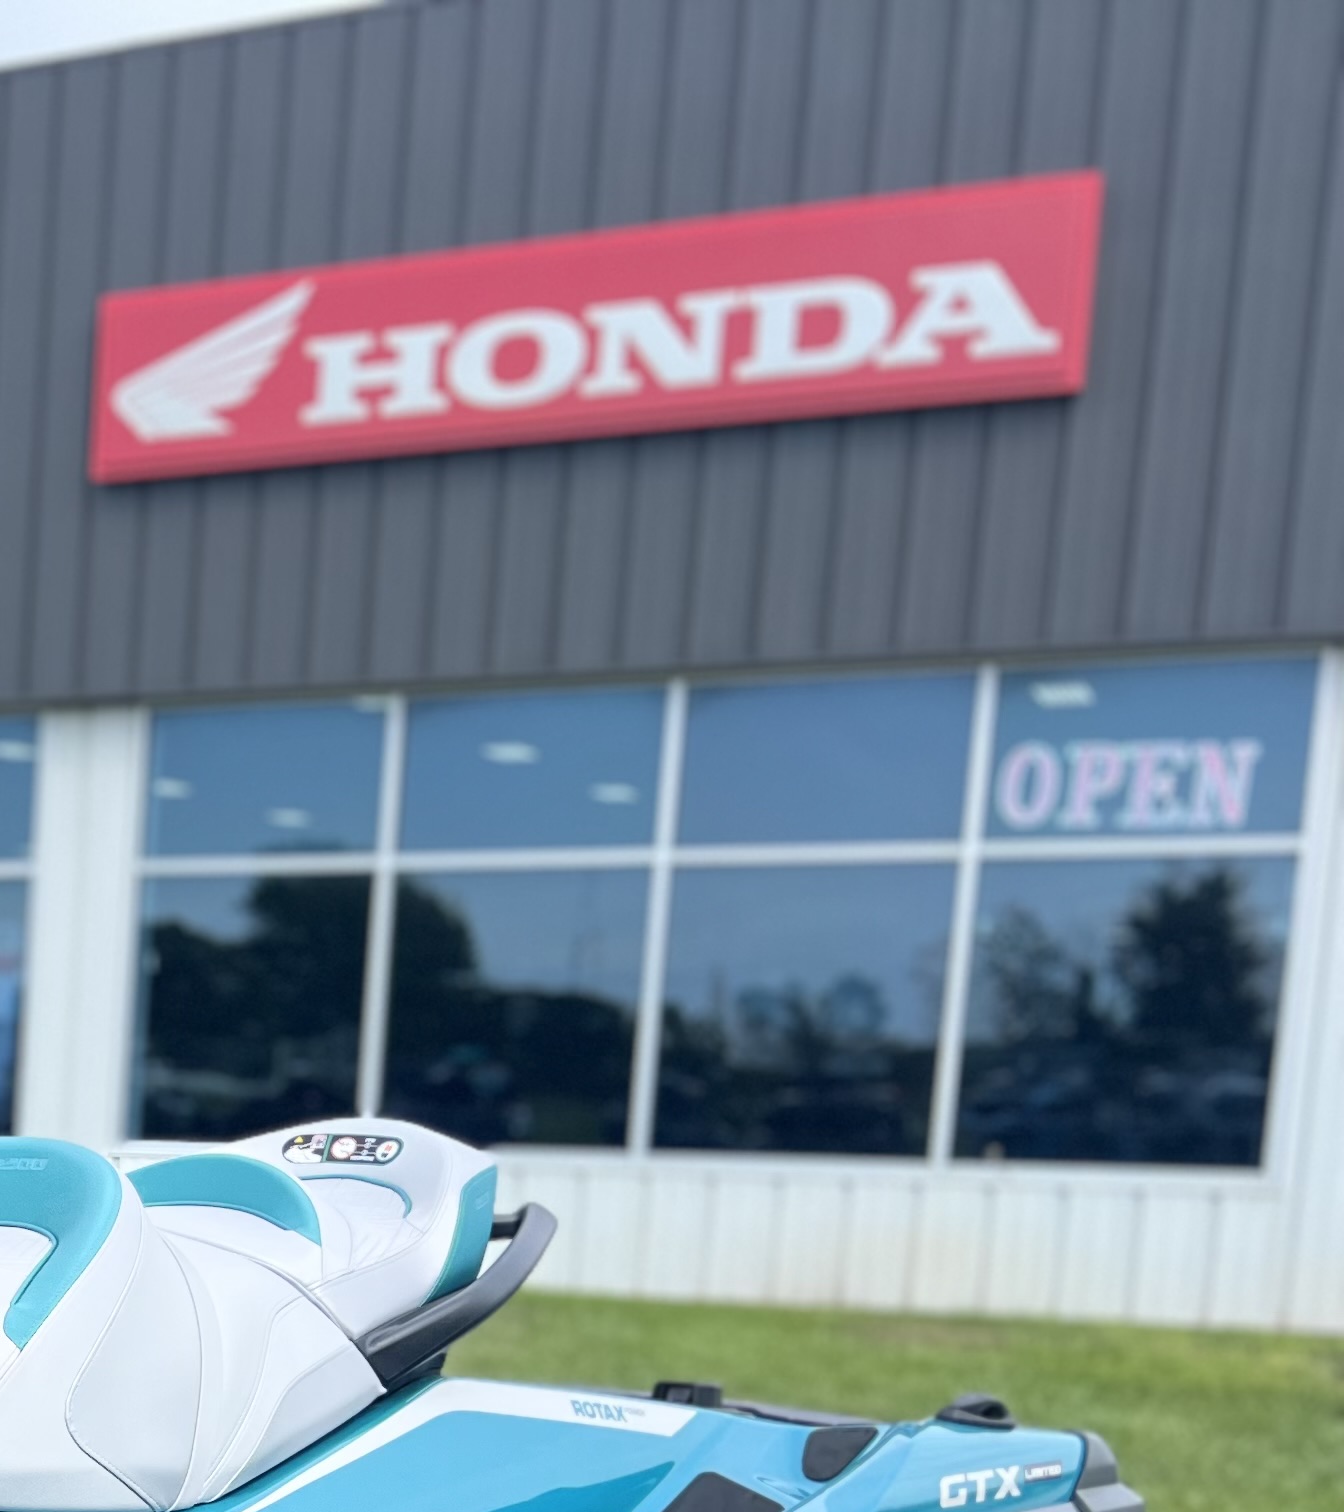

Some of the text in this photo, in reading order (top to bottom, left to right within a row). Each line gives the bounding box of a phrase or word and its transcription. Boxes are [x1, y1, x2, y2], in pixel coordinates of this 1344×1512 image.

[298, 259, 1061, 427] HONDA
[995, 738, 1263, 831] OPEN
[570, 1399, 628, 1423] ROTAX
[940, 1465, 1021, 1508] GTX
